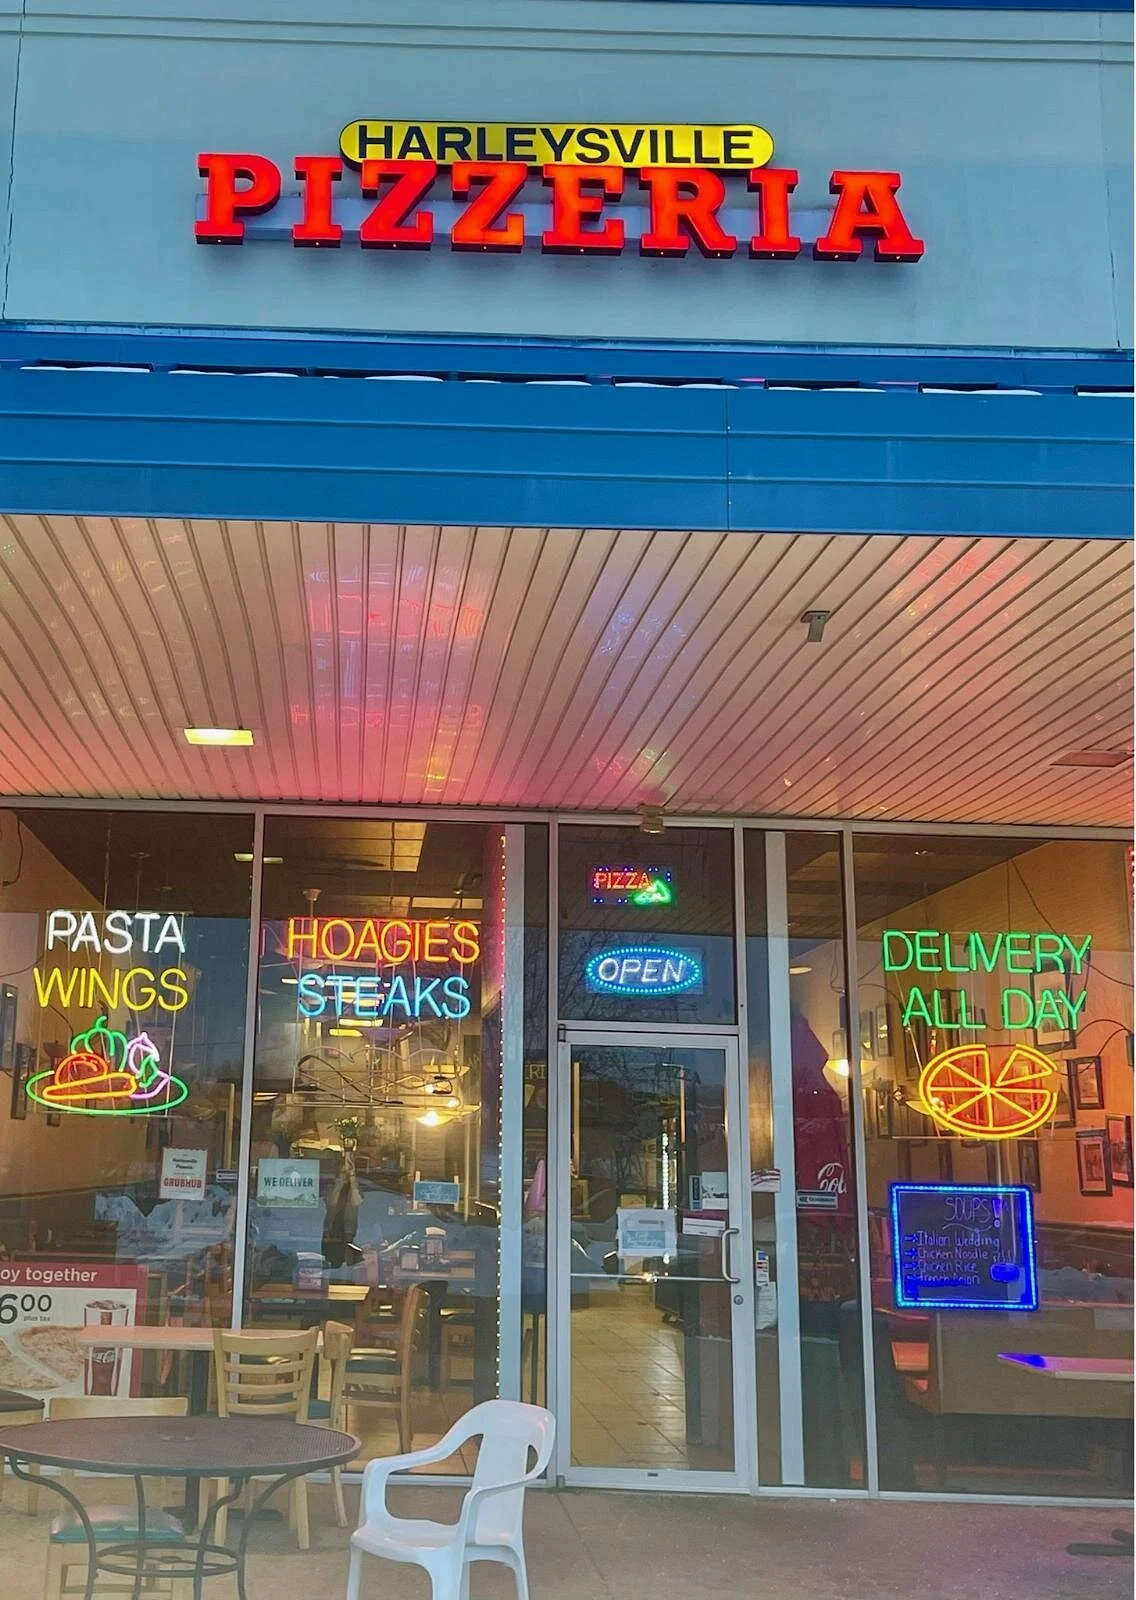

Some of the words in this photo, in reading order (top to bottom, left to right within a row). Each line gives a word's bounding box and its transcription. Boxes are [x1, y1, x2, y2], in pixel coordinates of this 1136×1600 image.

[358, 125, 755, 166] HARLEYSVILLE
[195, 153, 925, 262] PIZZERIA
[594, 872, 650, 889] PIZZA
[47, 910, 186, 954] PASTA
[288, 918, 480, 963] HOAGIES
[882, 930, 1092, 974] DELIVERY
[33, 967, 189, 1011] WINGS
[598, 957, 685, 984] OPEN
[298, 974, 471, 1019] STEAKS
[902, 987, 987, 1029] ALL
[1002, 988, 1088, 1030] DAY
[264, 1176, 277, 1187] WE
[279, 1176, 313, 1188] DELIVER
[26, 1267, 97, 1283] together
